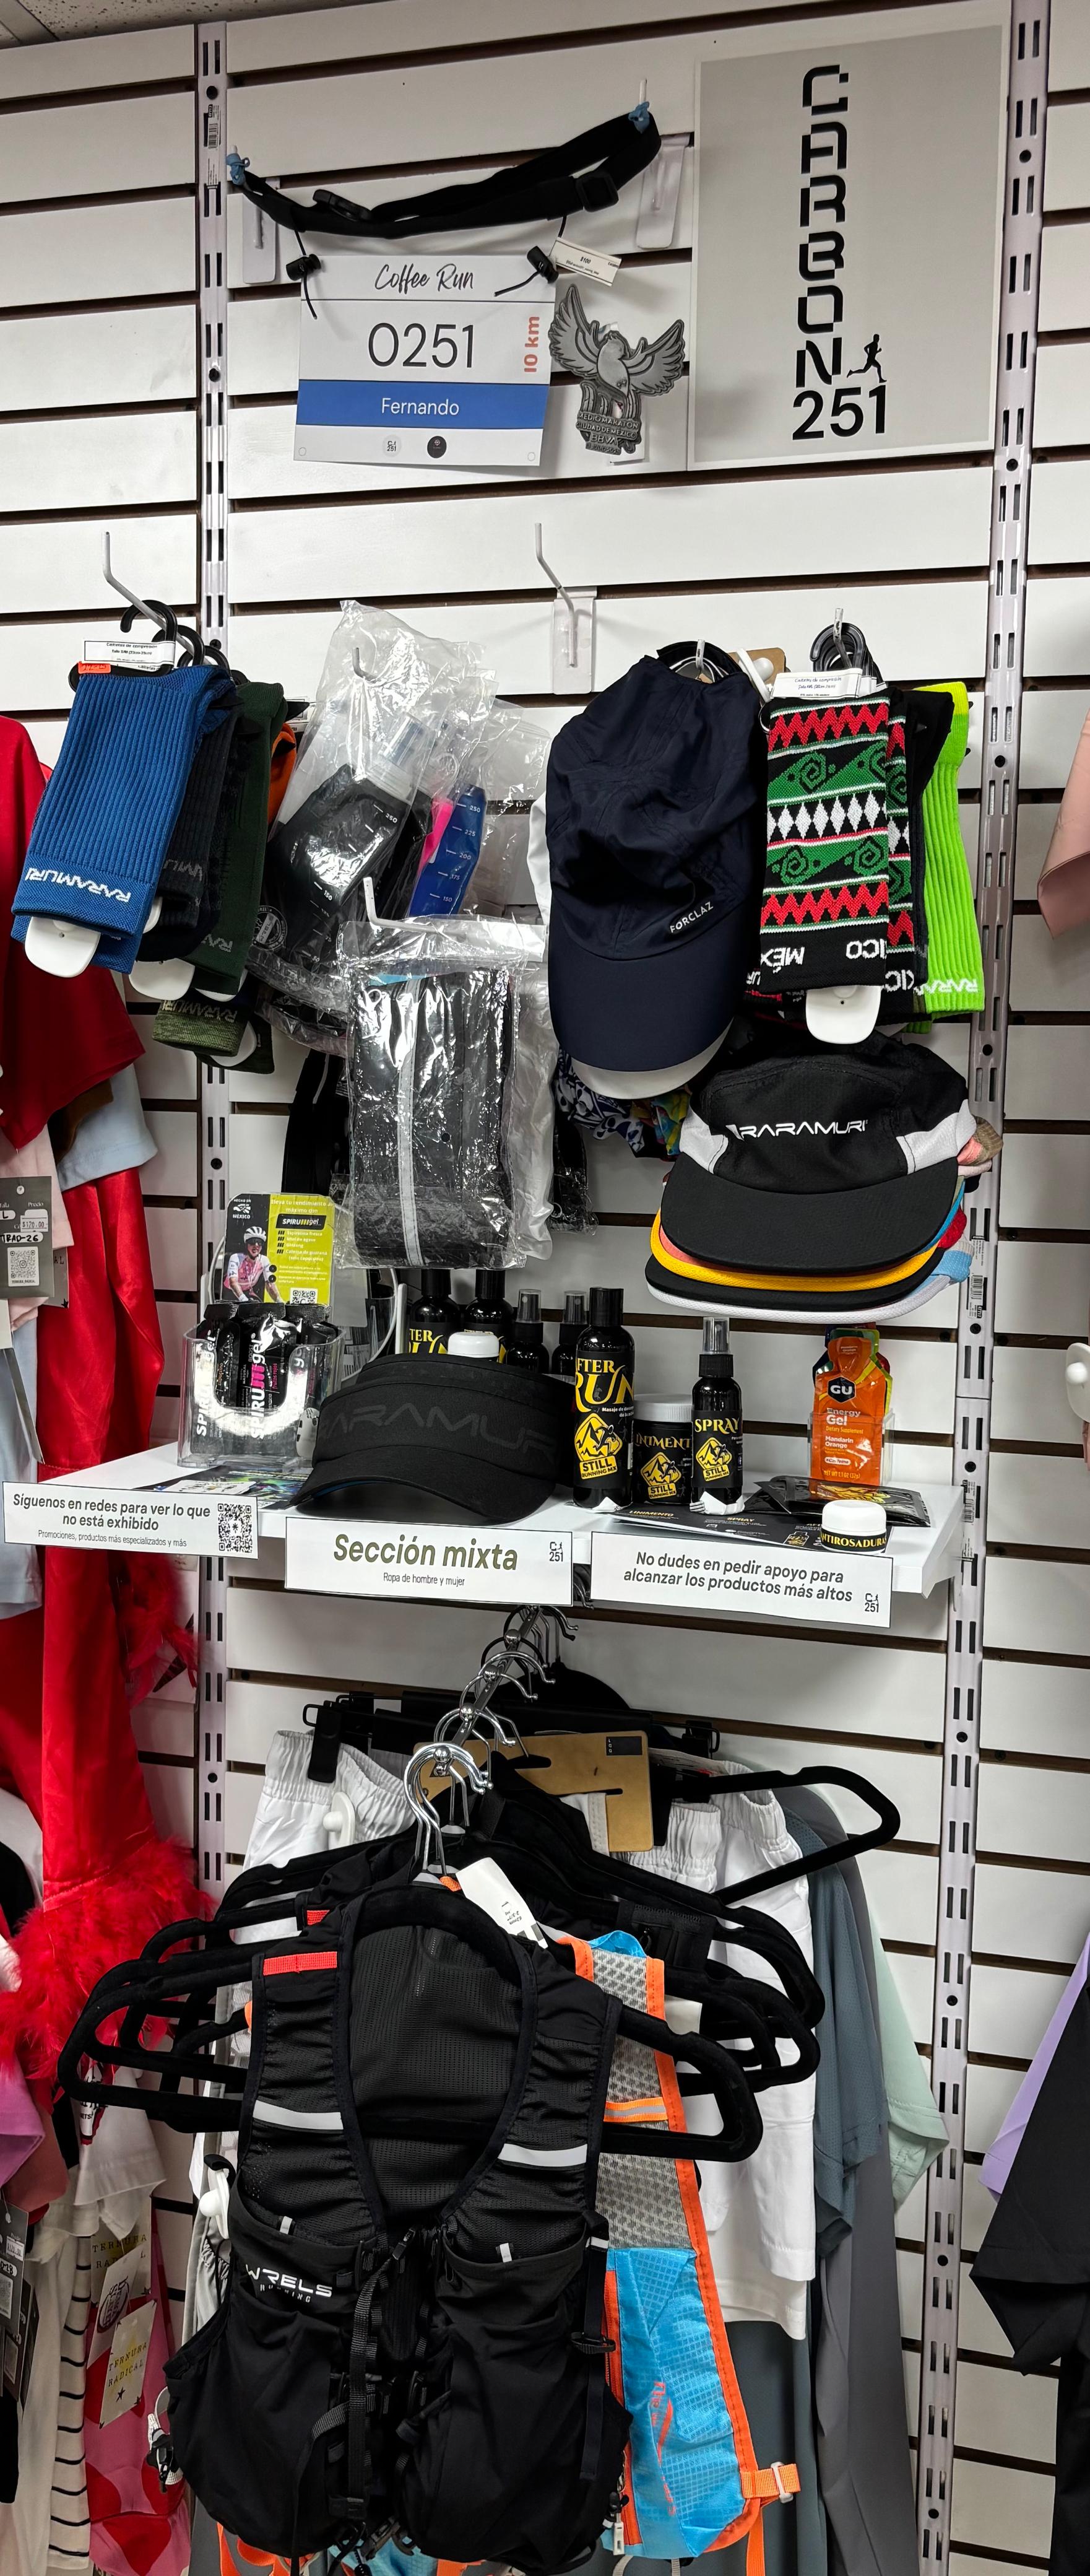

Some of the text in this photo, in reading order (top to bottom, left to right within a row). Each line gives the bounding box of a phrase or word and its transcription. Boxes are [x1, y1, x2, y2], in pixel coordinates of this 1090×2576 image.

[796, 64, 849, 388] CARBON
[374, 263, 474, 295] Coffee Run
[368, 323, 474, 368] 0251
[524, 316, 540, 373] 10 km
[381, 398, 459, 416] Fernando
[792, 384, 886, 441] 251
[576, 422, 600, 432] CIUDAD
[591, 434, 617, 445] BBVA
[385, 812, 398, 824] 250
[465, 829, 476, 837] 225
[25, 868, 131, 903] RARAMURI
[323, 890, 333, 901] 150
[670, 901, 714, 934] FORCLAZ
[740, 1120, 866, 1138] RARAMURI
[409, 1328, 434, 1342] TER
[577, 1358, 615, 1373] FTER
[830, 1385, 853, 1395] GU
[826, 1415, 847, 1426] Gel
[827, 1408, 861, 1417] Energy
[694, 1418, 740, 1434] SPRAY
[825, 1435, 854, 1443] Mandarin
[583, 1458, 612, 1472] STILL
[706, 1468, 726, 1477] STILL
[581, 1469, 607, 1478] RUNNING
[651, 1484, 673, 1494] STILL
[13, 1494, 211, 1521] Síguenos en redes para ver lo que
[63, 1514, 159, 1531] no está exhibido
[38, 1530, 77, 1541] Promociones,
[79, 1533, 107, 1543] productos
[108, 1534, 121, 1544] más
[123, 1536, 167, 1547] especializados
[173, 1538, 187, 1547] más
[333, 1533, 518, 1571] Sección mixta
[549, 1552, 564, 1563] 251
[636, 1552, 844, 1586] No dudes en pedir apoyo para
[383, 1572, 465, 1587] Ropa de hombre y mujer
[623, 1569, 853, 1602] alcanzar los productos más altos
[865, 1602, 880, 1613] 251
[246, 2264, 332, 2297] WRELS
[260, 2284, 311, 2303] RUNING
[108, 2342, 147, 2372] TERNURA
[108, 2359, 144, 2388] RADICAL
